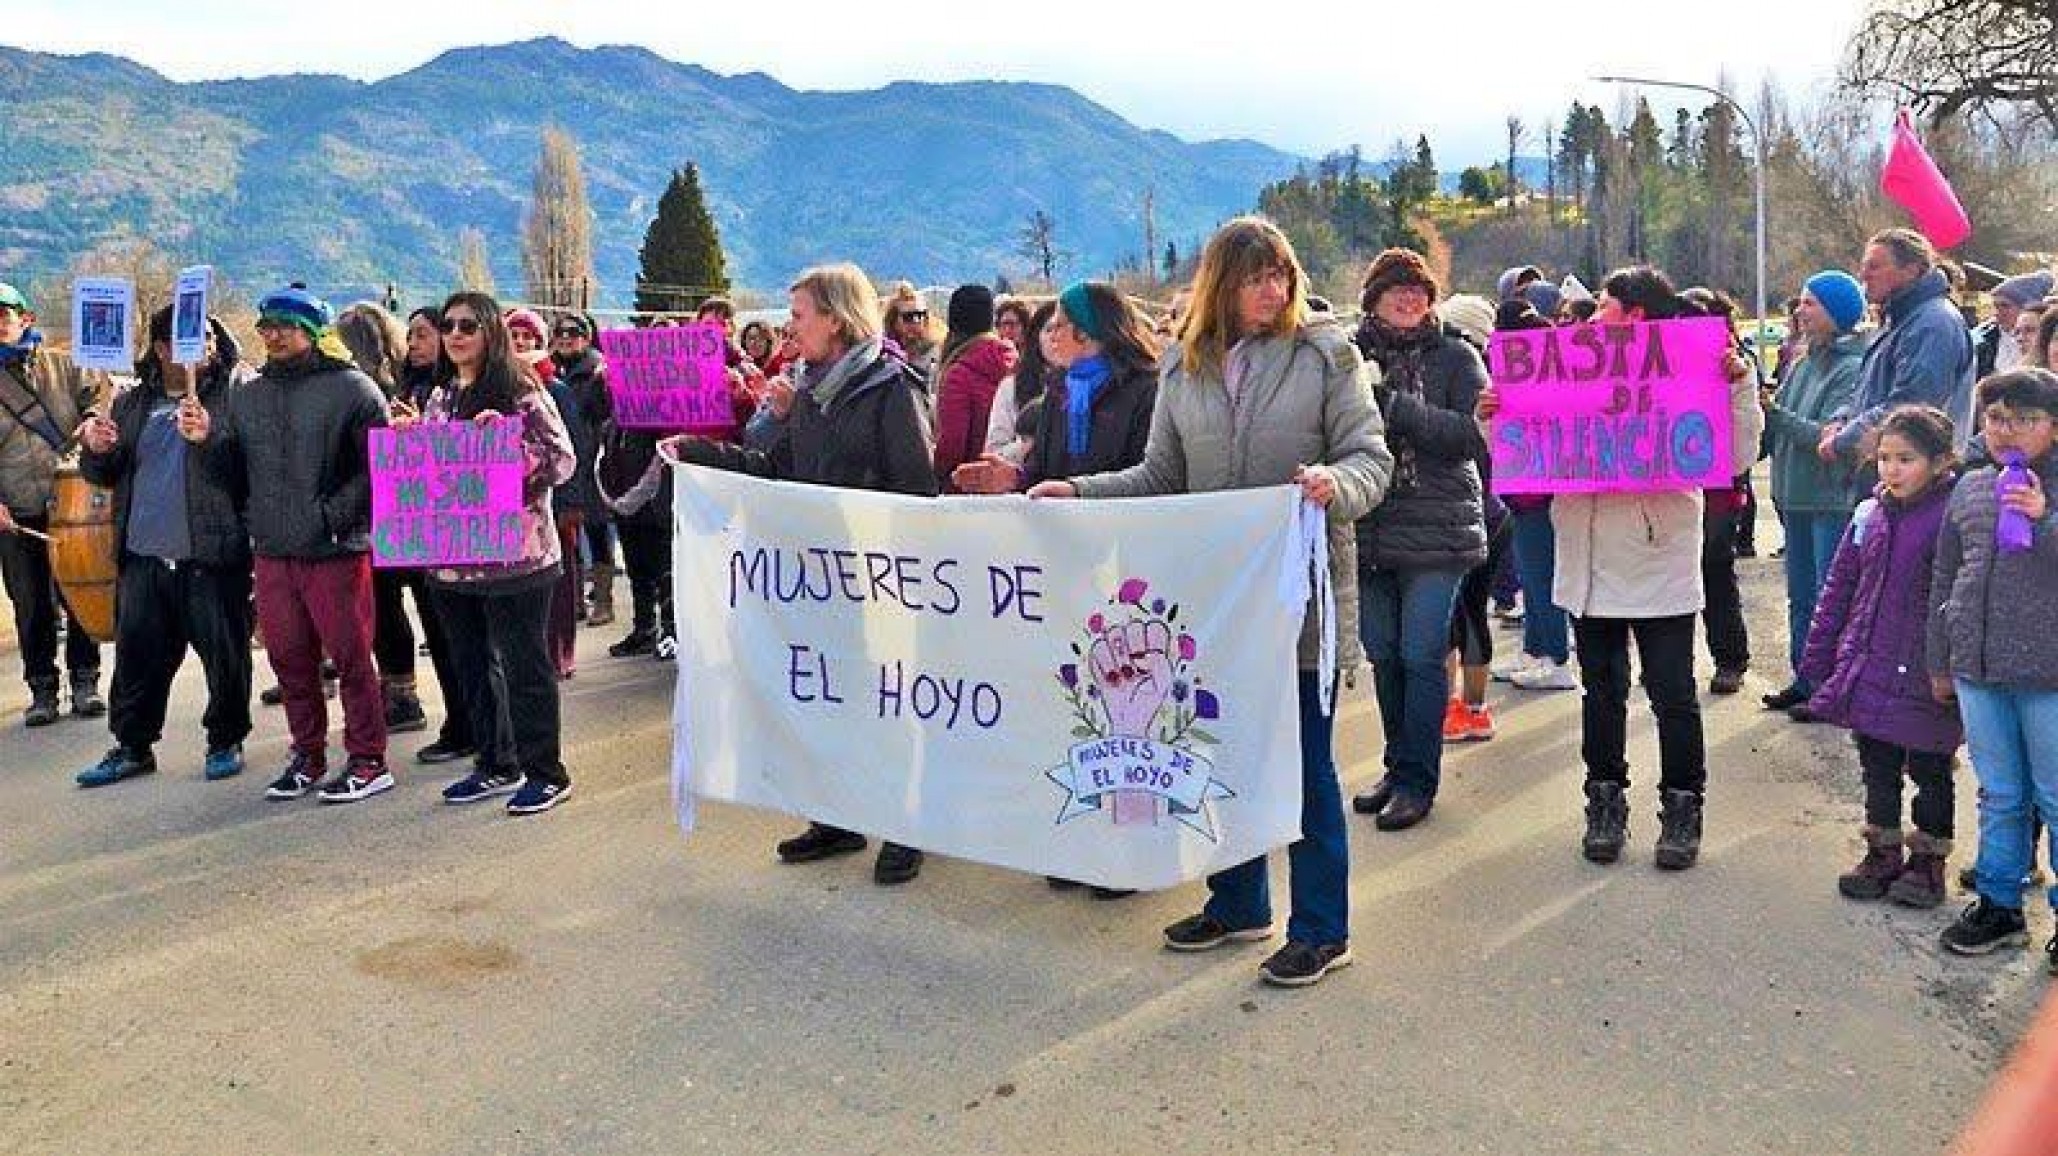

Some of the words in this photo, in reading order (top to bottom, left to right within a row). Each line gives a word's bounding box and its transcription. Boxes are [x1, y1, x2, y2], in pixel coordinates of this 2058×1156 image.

[1502, 323, 1673, 383] BASTA
[730, 547, 961, 615] MUJERES
[987, 565, 1044, 623] DE
[788, 643, 845, 703] EL
[879, 658, 1002, 730] HOYO
[1091, 767, 1115, 788] EL
[1123, 764, 1174, 790] HOYO
